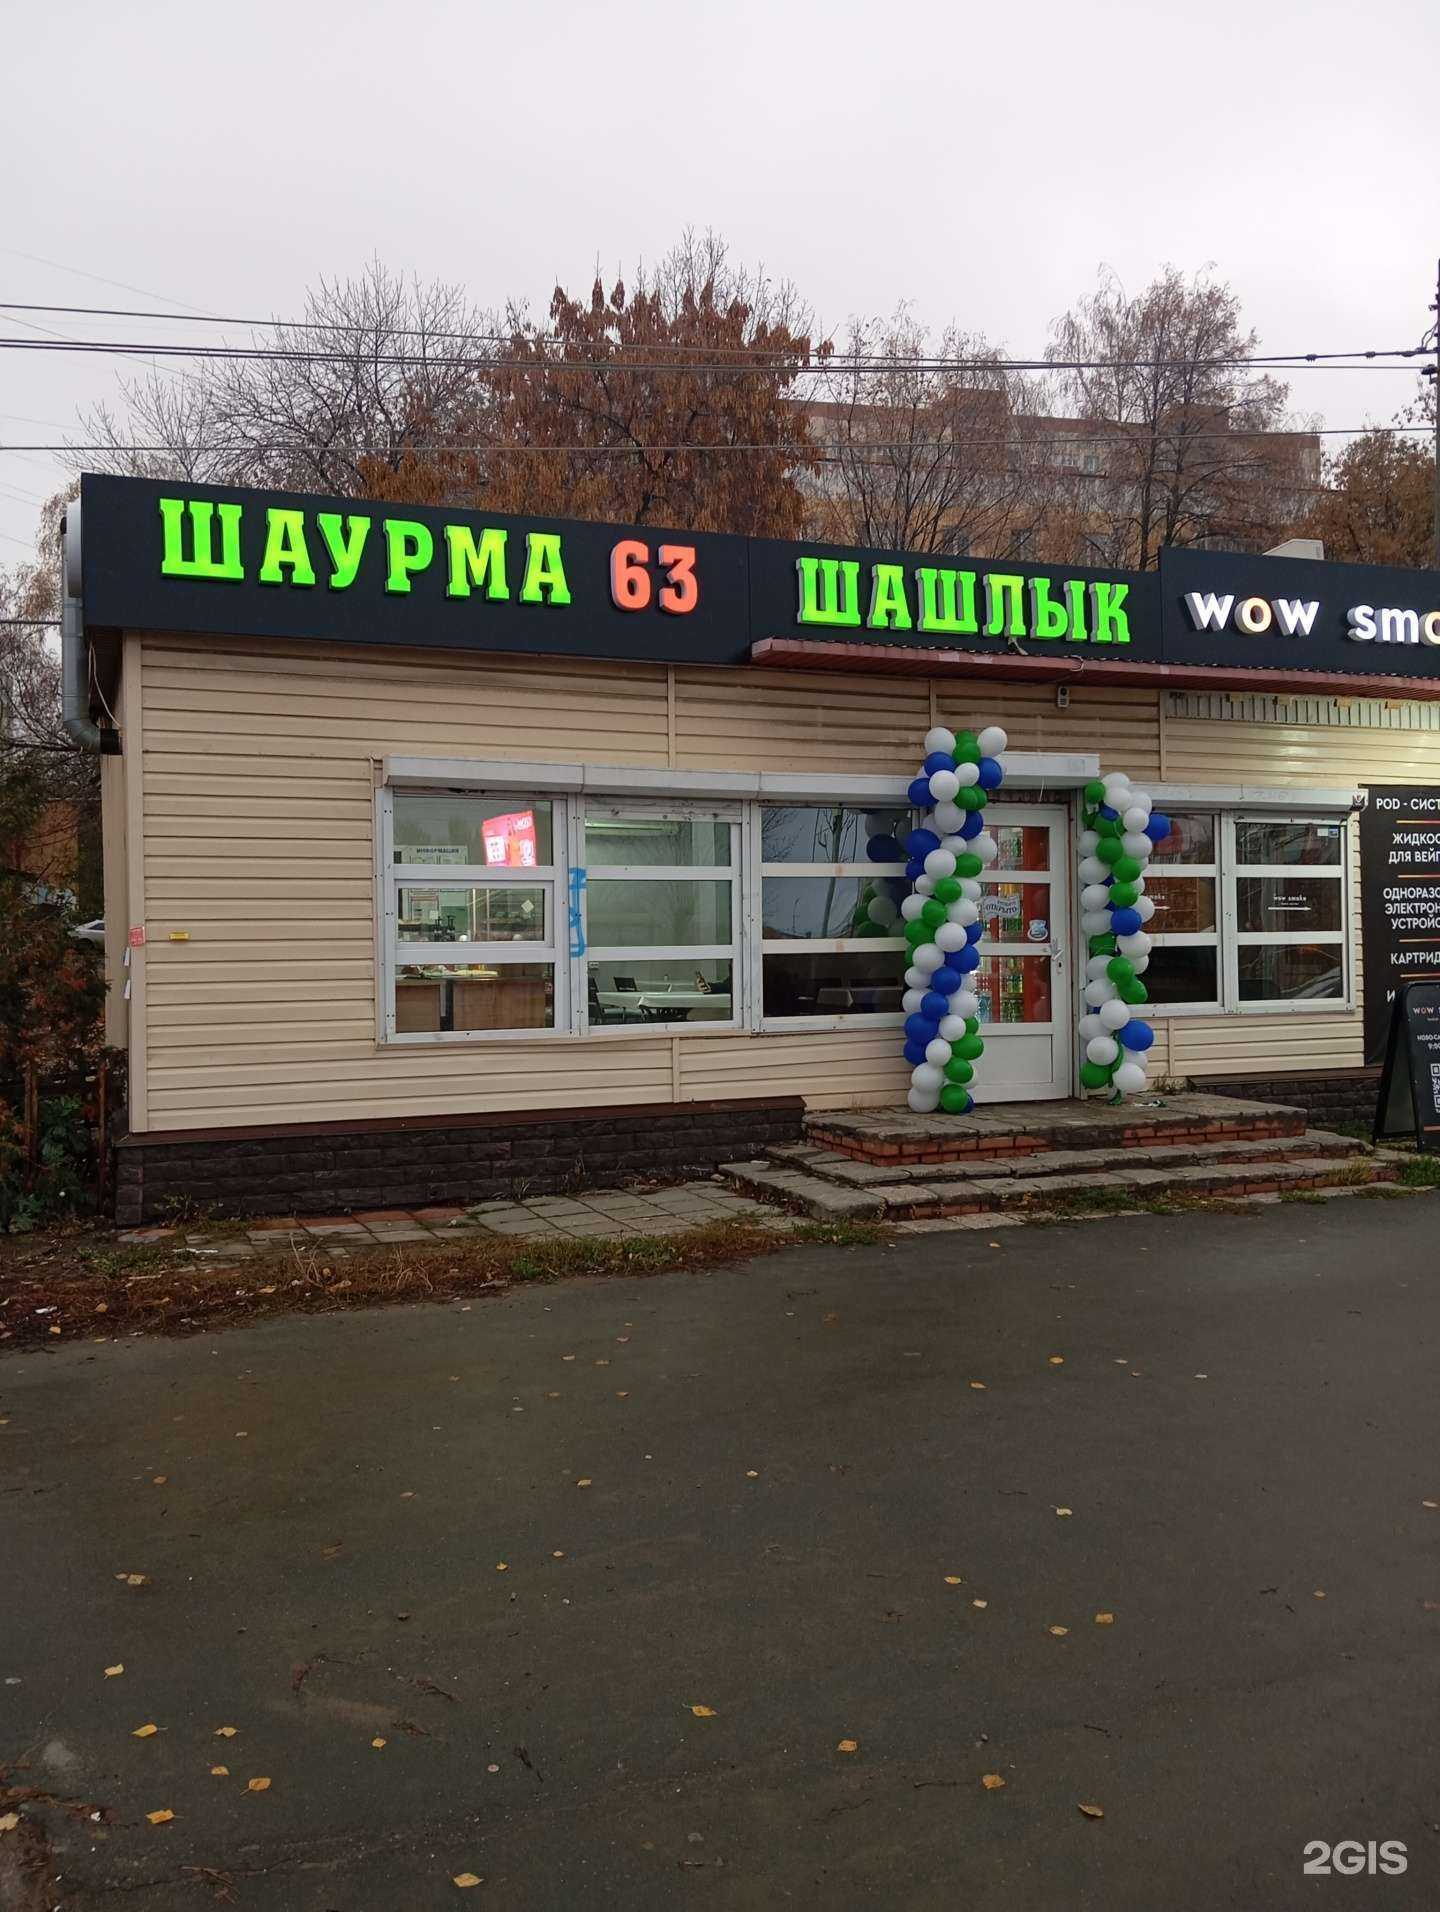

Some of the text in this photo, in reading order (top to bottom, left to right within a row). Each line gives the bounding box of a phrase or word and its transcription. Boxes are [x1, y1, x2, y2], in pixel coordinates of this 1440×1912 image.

[159, 498, 699, 615] ШАУРМА 63
[796, 557, 1131, 644] ШАШЛЫК
[1346, 604, 1440, 647] smo
[1376, 797, 1400, 810] POD
[1388, 850, 1412, 864] ДЛЯ
